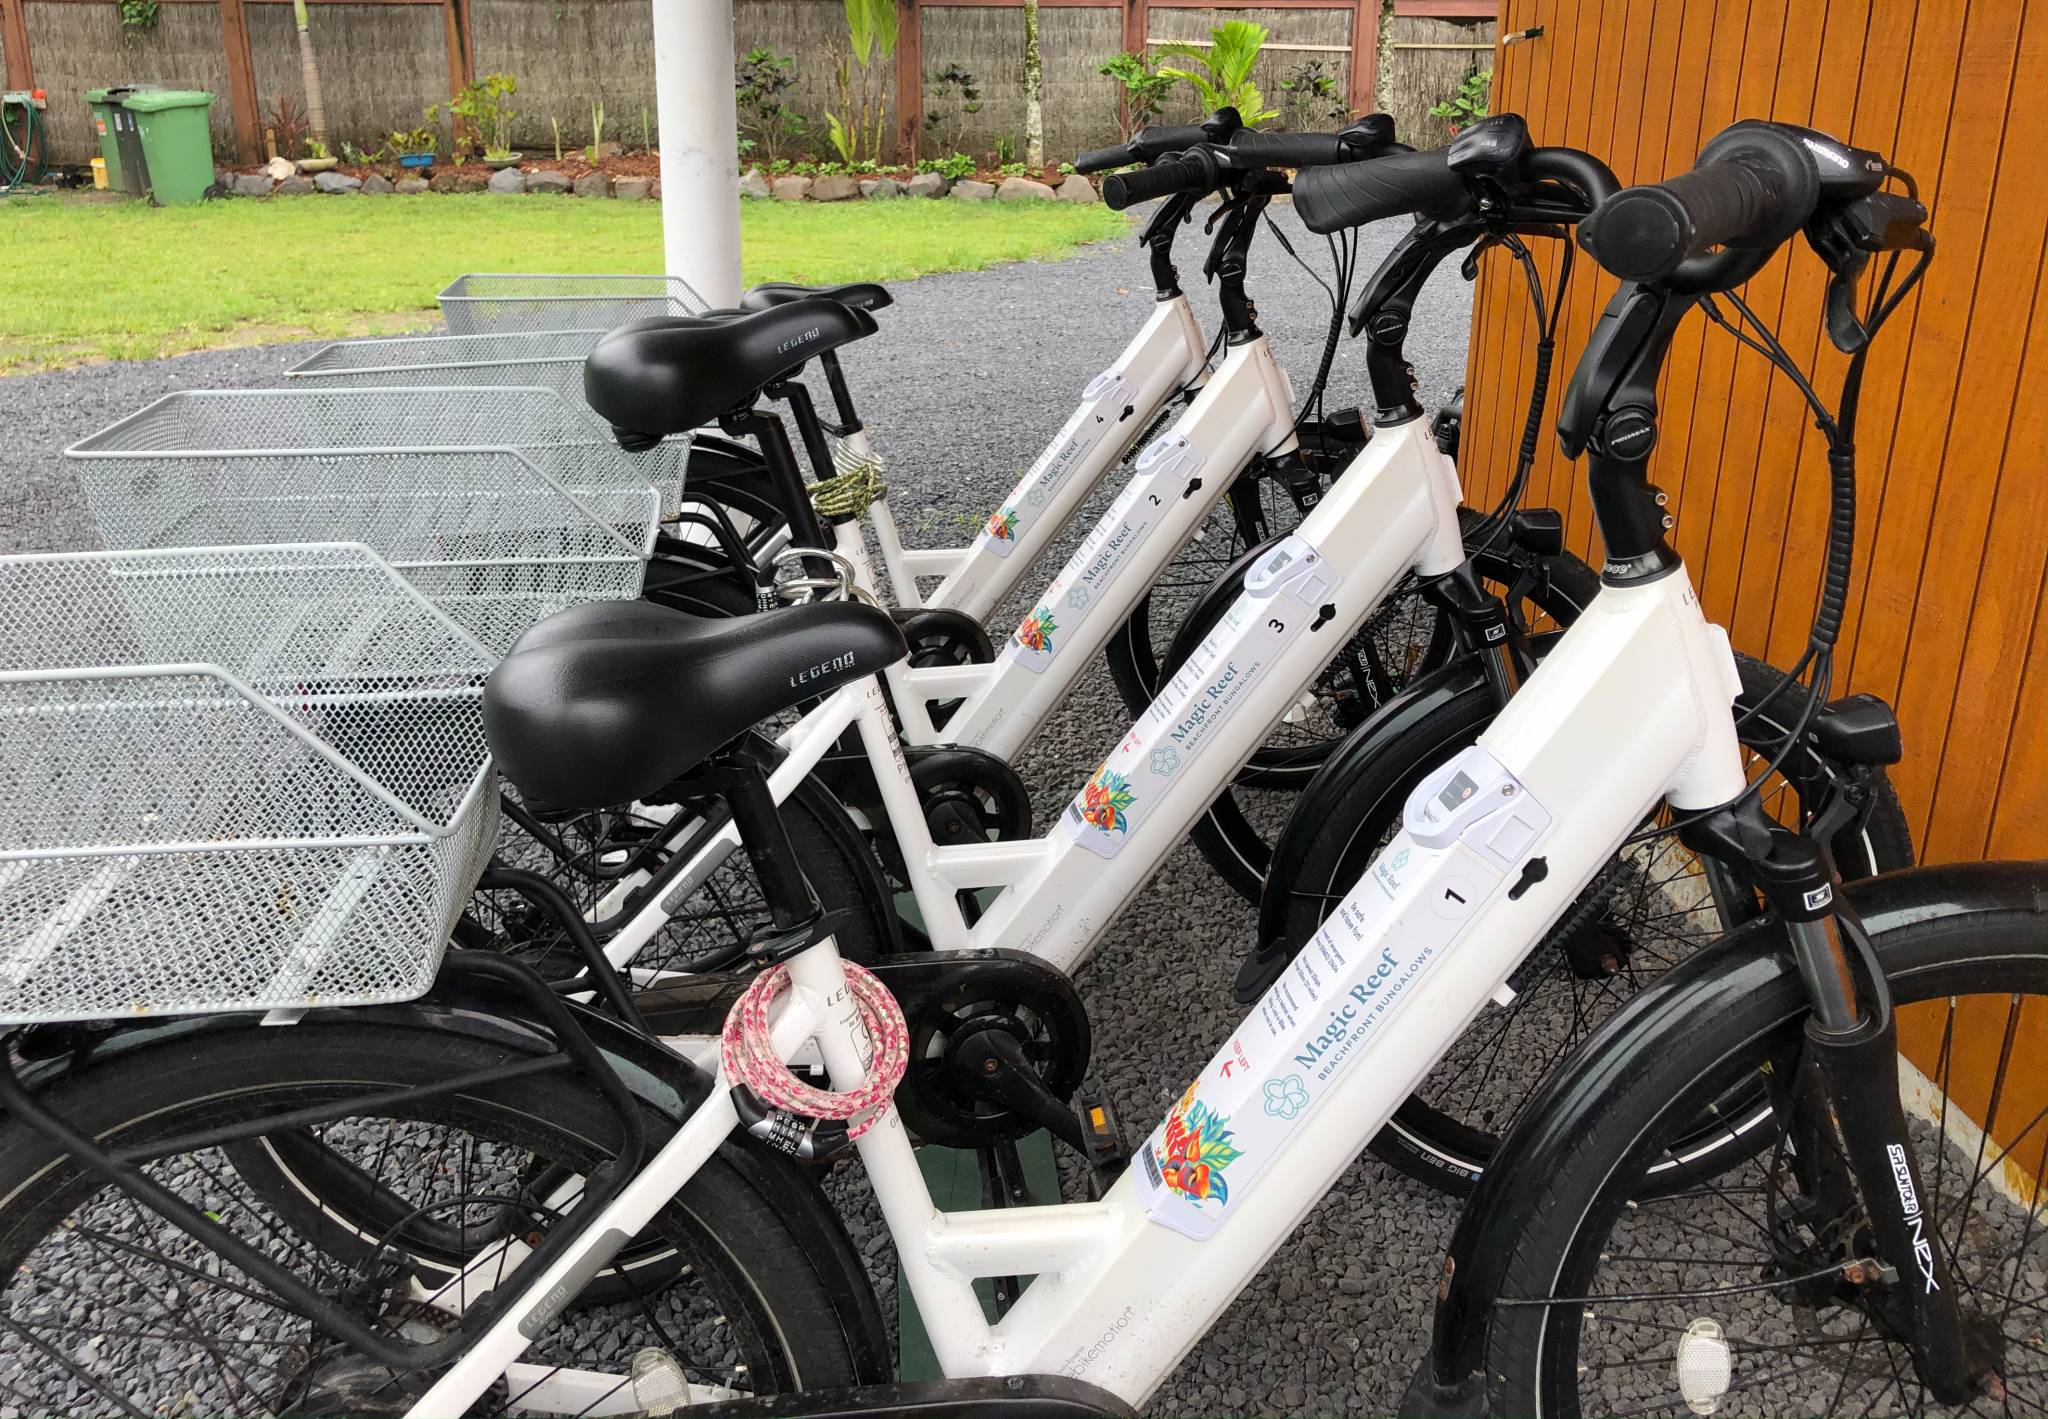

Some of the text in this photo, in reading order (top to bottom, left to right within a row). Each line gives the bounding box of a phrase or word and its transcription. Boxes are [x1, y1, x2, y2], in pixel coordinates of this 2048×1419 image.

[777, 327, 820, 354] LEGEND
[1095, 414, 1104, 424] 4
[1611, 427, 1652, 445] PROMAX
[1040, 462, 1063, 487] Magic
[1060, 438, 1078, 461] Reef
[1148, 494, 1162, 506] 2
[1082, 550, 1112, 585] Magic
[1109, 521, 1132, 551] Reef
[1120, 521, 1148, 556] BUNGALOWS
[1268, 618, 1285, 634] 3
[790, 651, 856, 688] LEGEND
[1170, 697, 1212, 743] Magic
[1206, 661, 1240, 700] Reef
[1185, 704, 1225, 751] BEACHFRONT
[1223, 661, 1261, 705] BUNGALOWS
[1363, 668, 1382, 710] NEX
[1444, 888, 1467, 904] 1
[1294, 1004, 1357, 1070] Magic
[1348, 947, 1399, 1005] Reef
[1318, 1012, 1377, 1081] BEACHFRONT
[1375, 946, 1433, 1013] BUNGALOWS
[1420, 1151, 1469, 1178] BIG BEN
[1907, 1217, 1941, 1294] NEX
